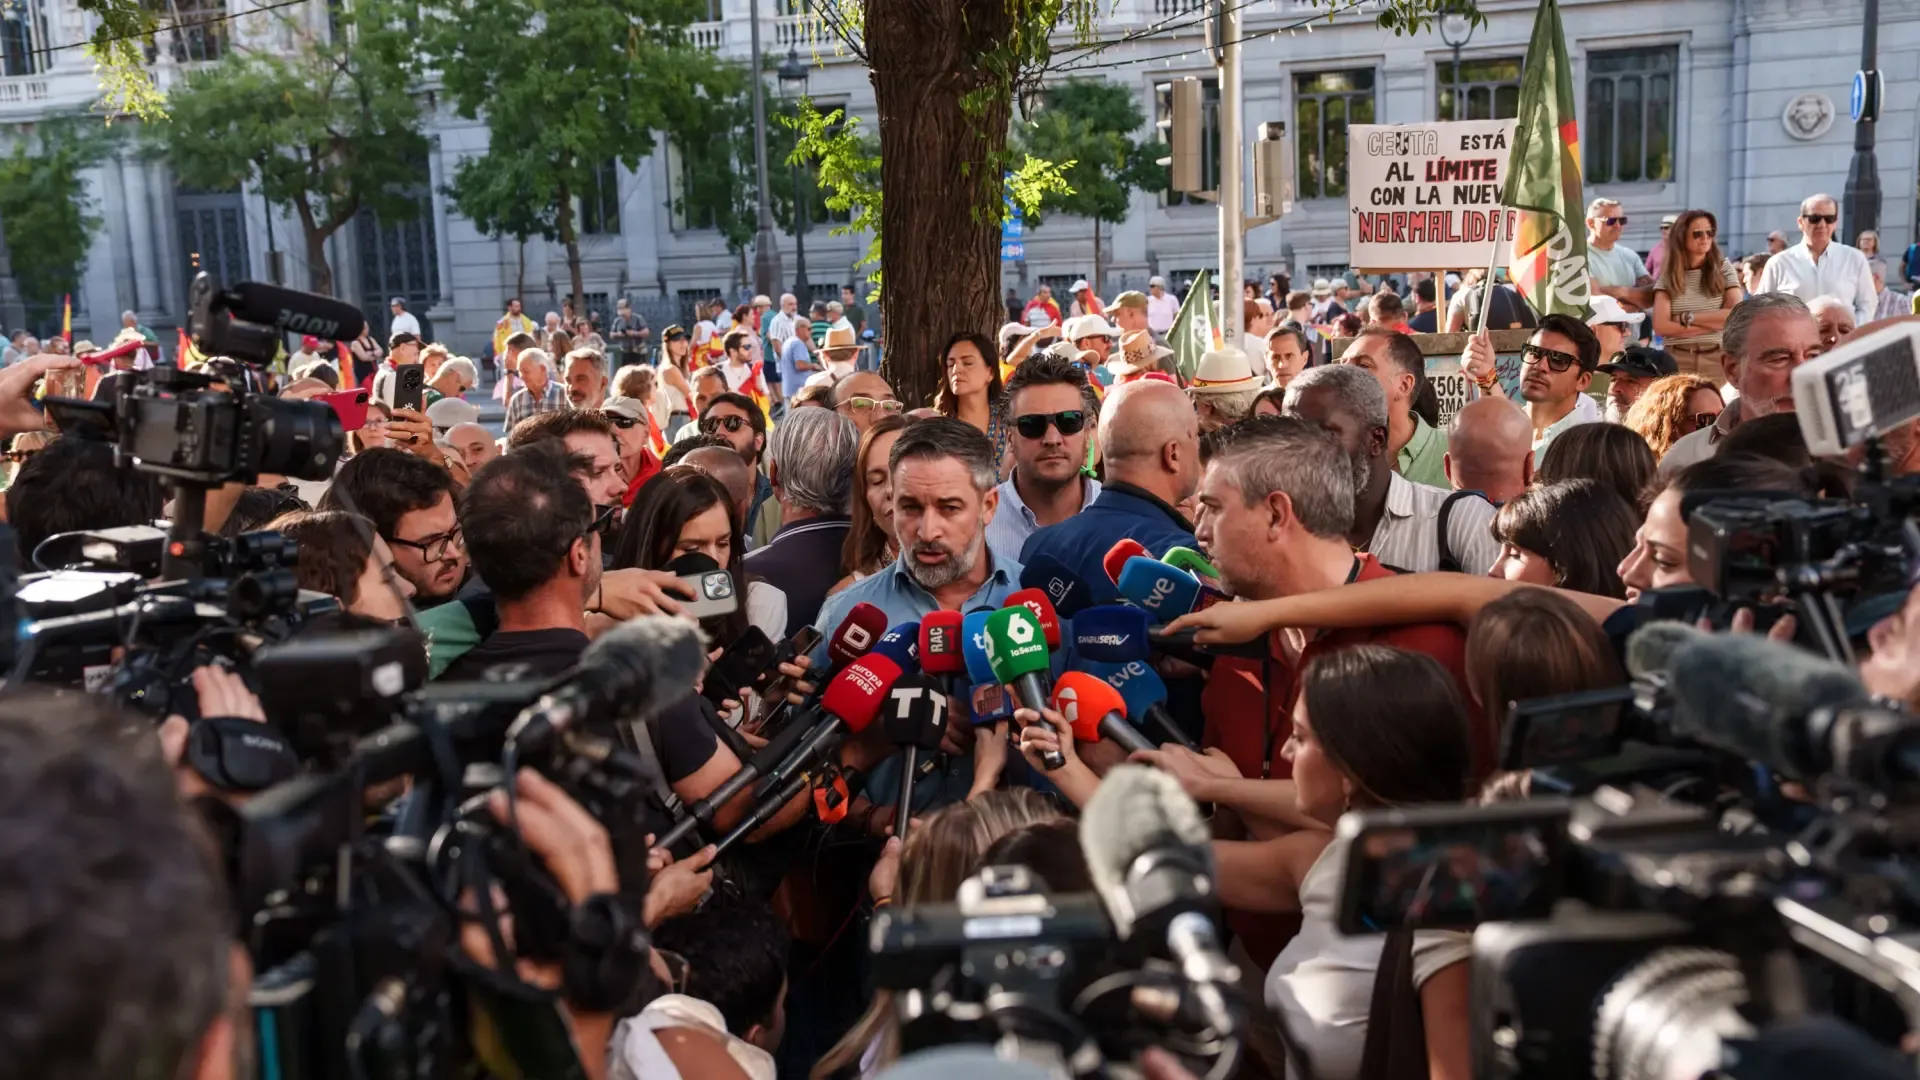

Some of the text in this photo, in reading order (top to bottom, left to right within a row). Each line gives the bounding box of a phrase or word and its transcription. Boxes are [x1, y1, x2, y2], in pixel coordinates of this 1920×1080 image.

[1368, 128, 1507, 156] CEUTA ESTÁ
[1385, 156, 1497, 183] AL LÍMITE
[1370, 184, 1503, 206] CON LA NUEV
[1143, 577, 1176, 608] tve
[843, 622, 871, 650] D
[930, 627, 944, 653] RAC
[1006, 612, 1035, 645] 6
[1010, 644, 1042, 657] laSexta
[846, 673, 877, 696] press
[851, 663, 883, 688] europa
[1108, 661, 1146, 688] tve
